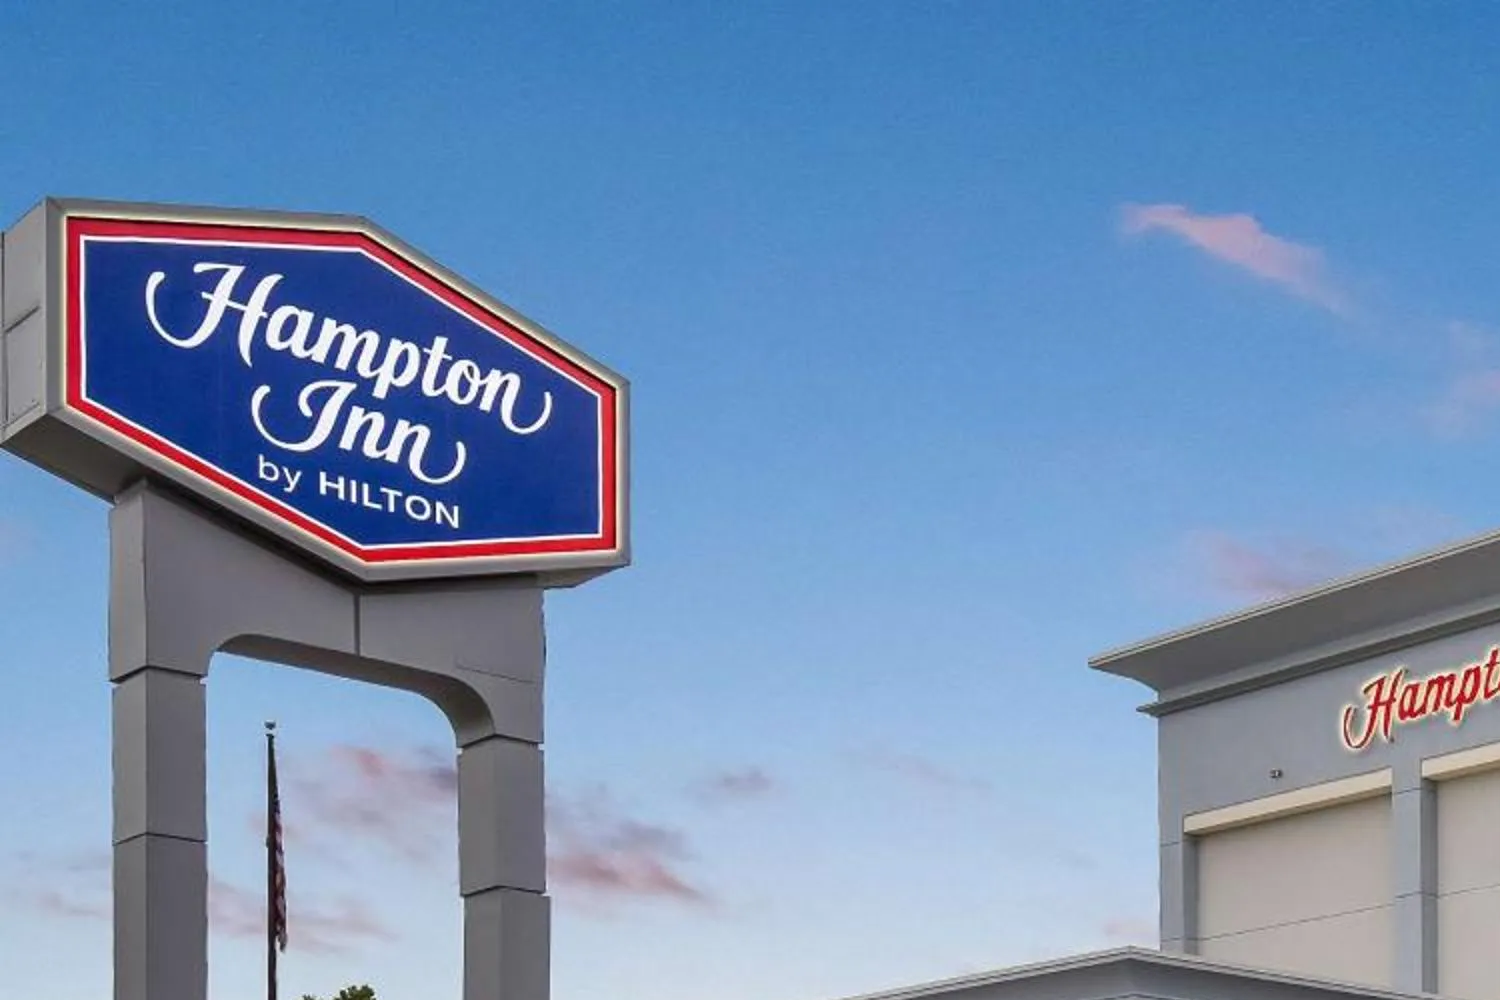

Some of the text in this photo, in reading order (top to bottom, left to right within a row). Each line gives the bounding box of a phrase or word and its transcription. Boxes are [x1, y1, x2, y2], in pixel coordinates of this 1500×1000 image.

[146, 262, 552, 434] Hampton
[251, 380, 466, 484] Inn
[258, 454, 459, 529] by HILTON
